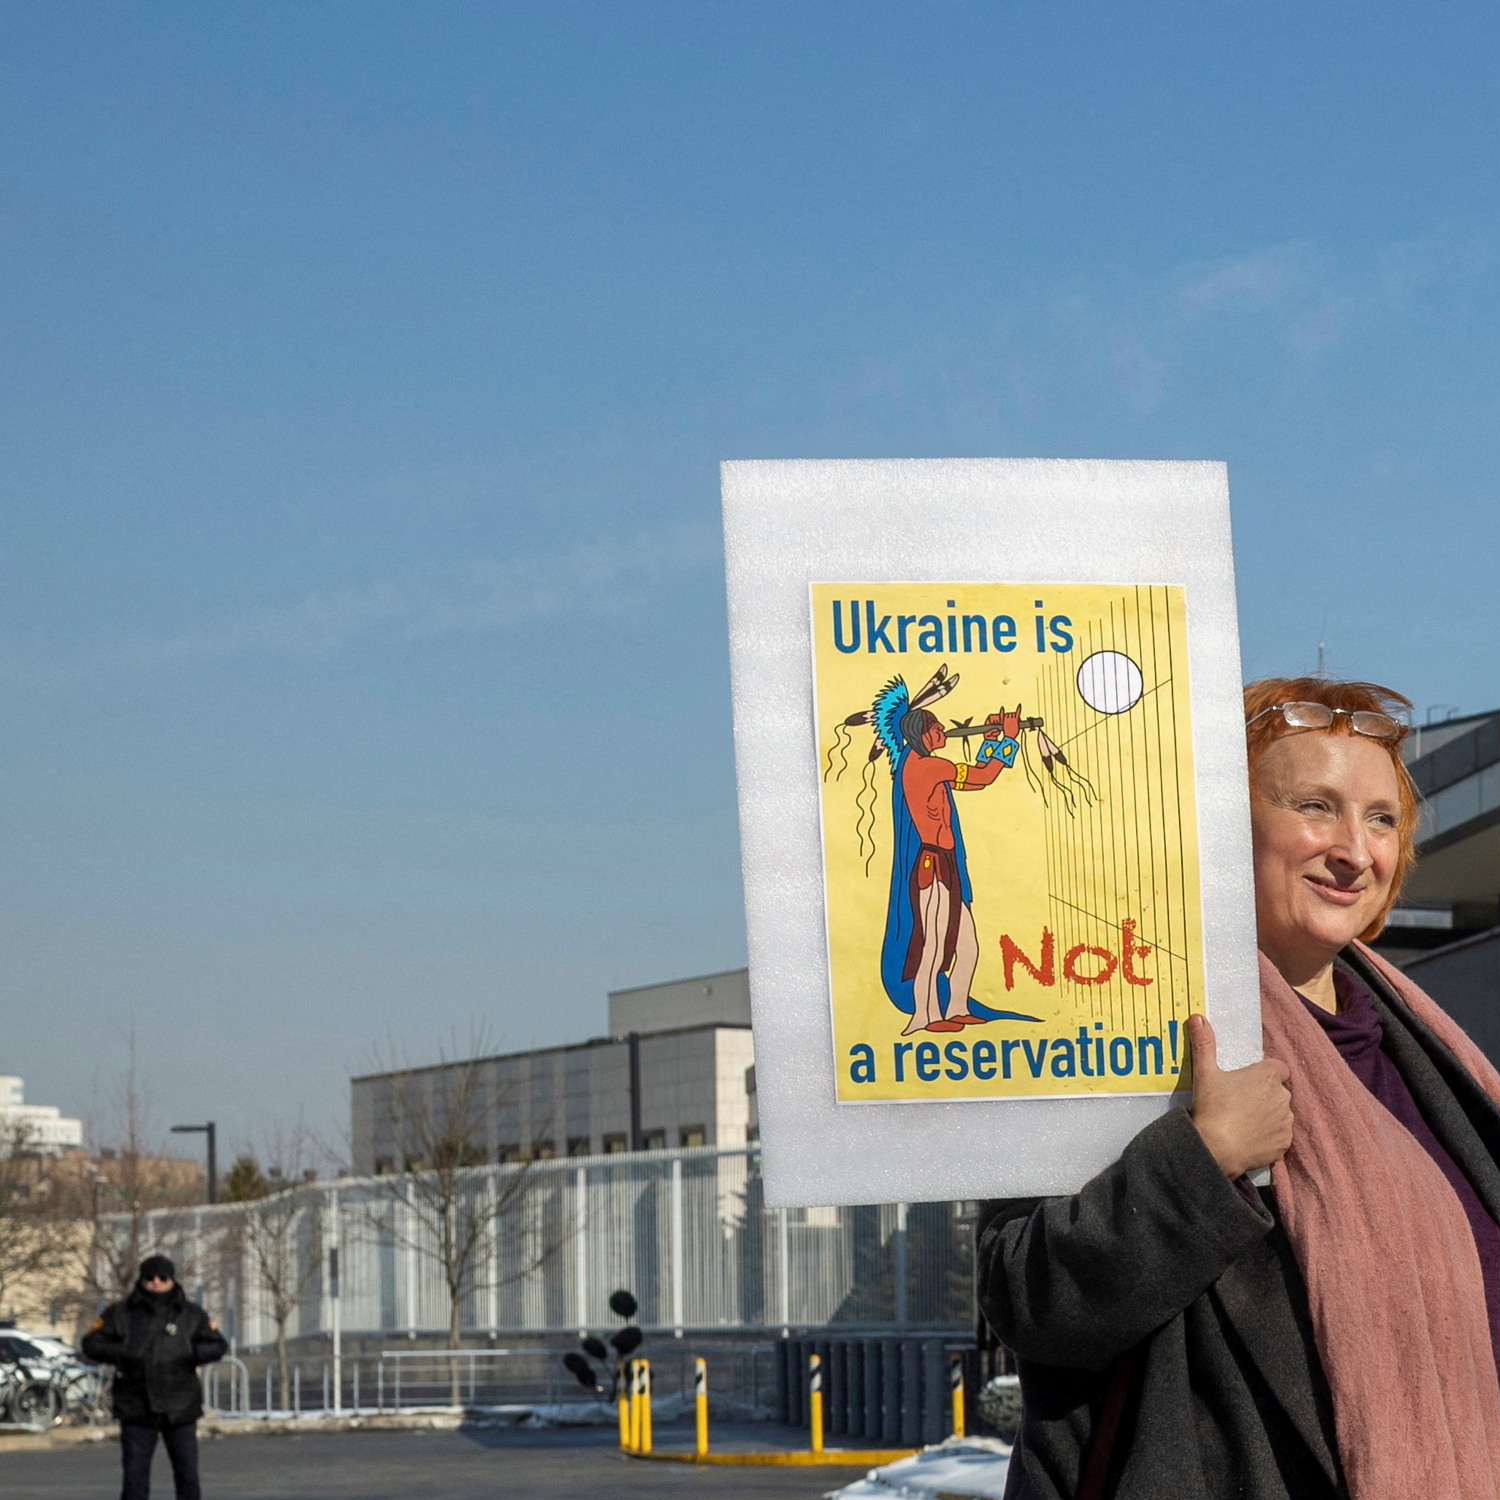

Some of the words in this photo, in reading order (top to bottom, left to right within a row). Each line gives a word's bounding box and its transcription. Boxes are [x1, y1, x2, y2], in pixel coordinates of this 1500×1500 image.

[832, 600, 1017, 654] Ukraine
[1035, 600, 1074, 653] is
[998, 917, 1154, 991] Not
[850, 1042, 875, 1083] a
[893, 1020, 1182, 1083] reservation!
